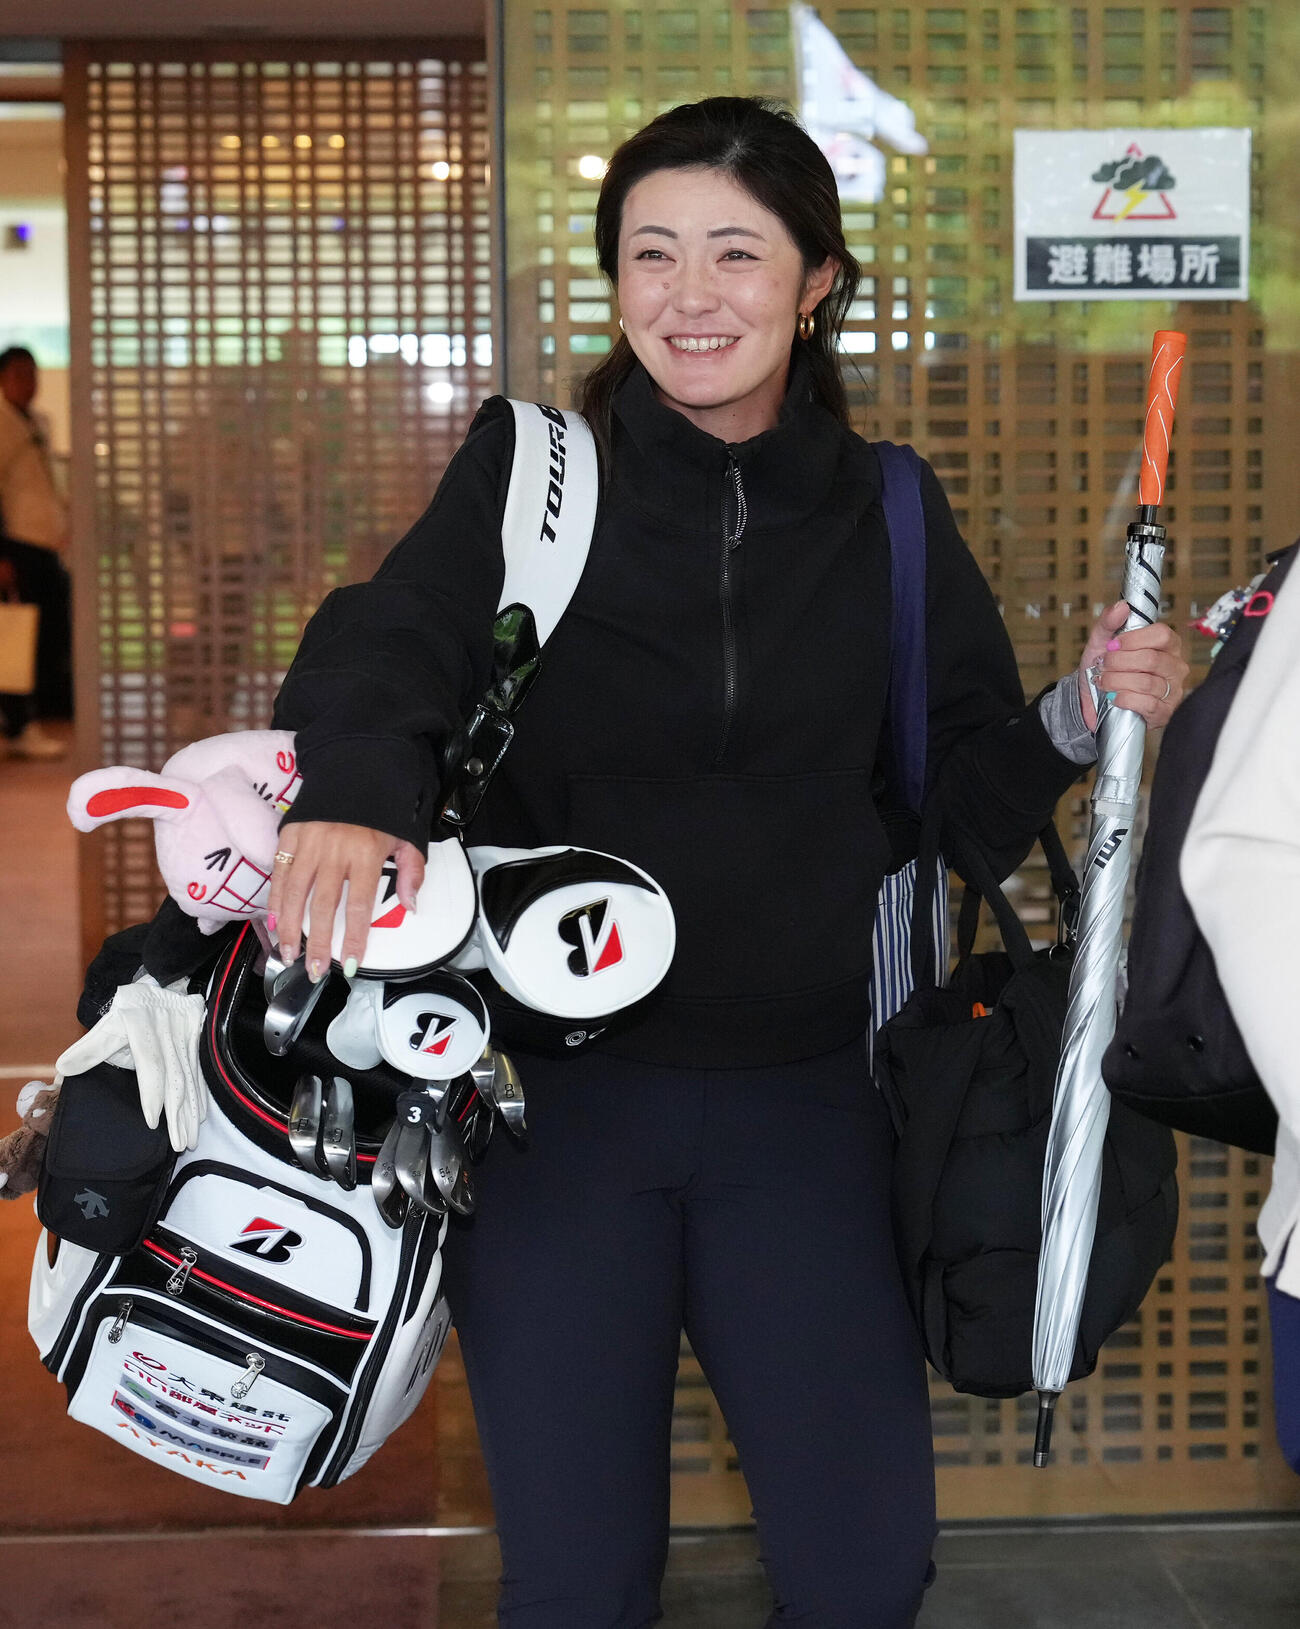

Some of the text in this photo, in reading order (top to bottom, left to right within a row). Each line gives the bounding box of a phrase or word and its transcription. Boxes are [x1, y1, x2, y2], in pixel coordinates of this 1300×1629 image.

[1047, 243, 1220, 285] 避難場所
[407, 1106, 422, 1124] 3
[116, 1422, 247, 1481] AYAKA
[153, 1430, 262, 1465] MAPPLE
